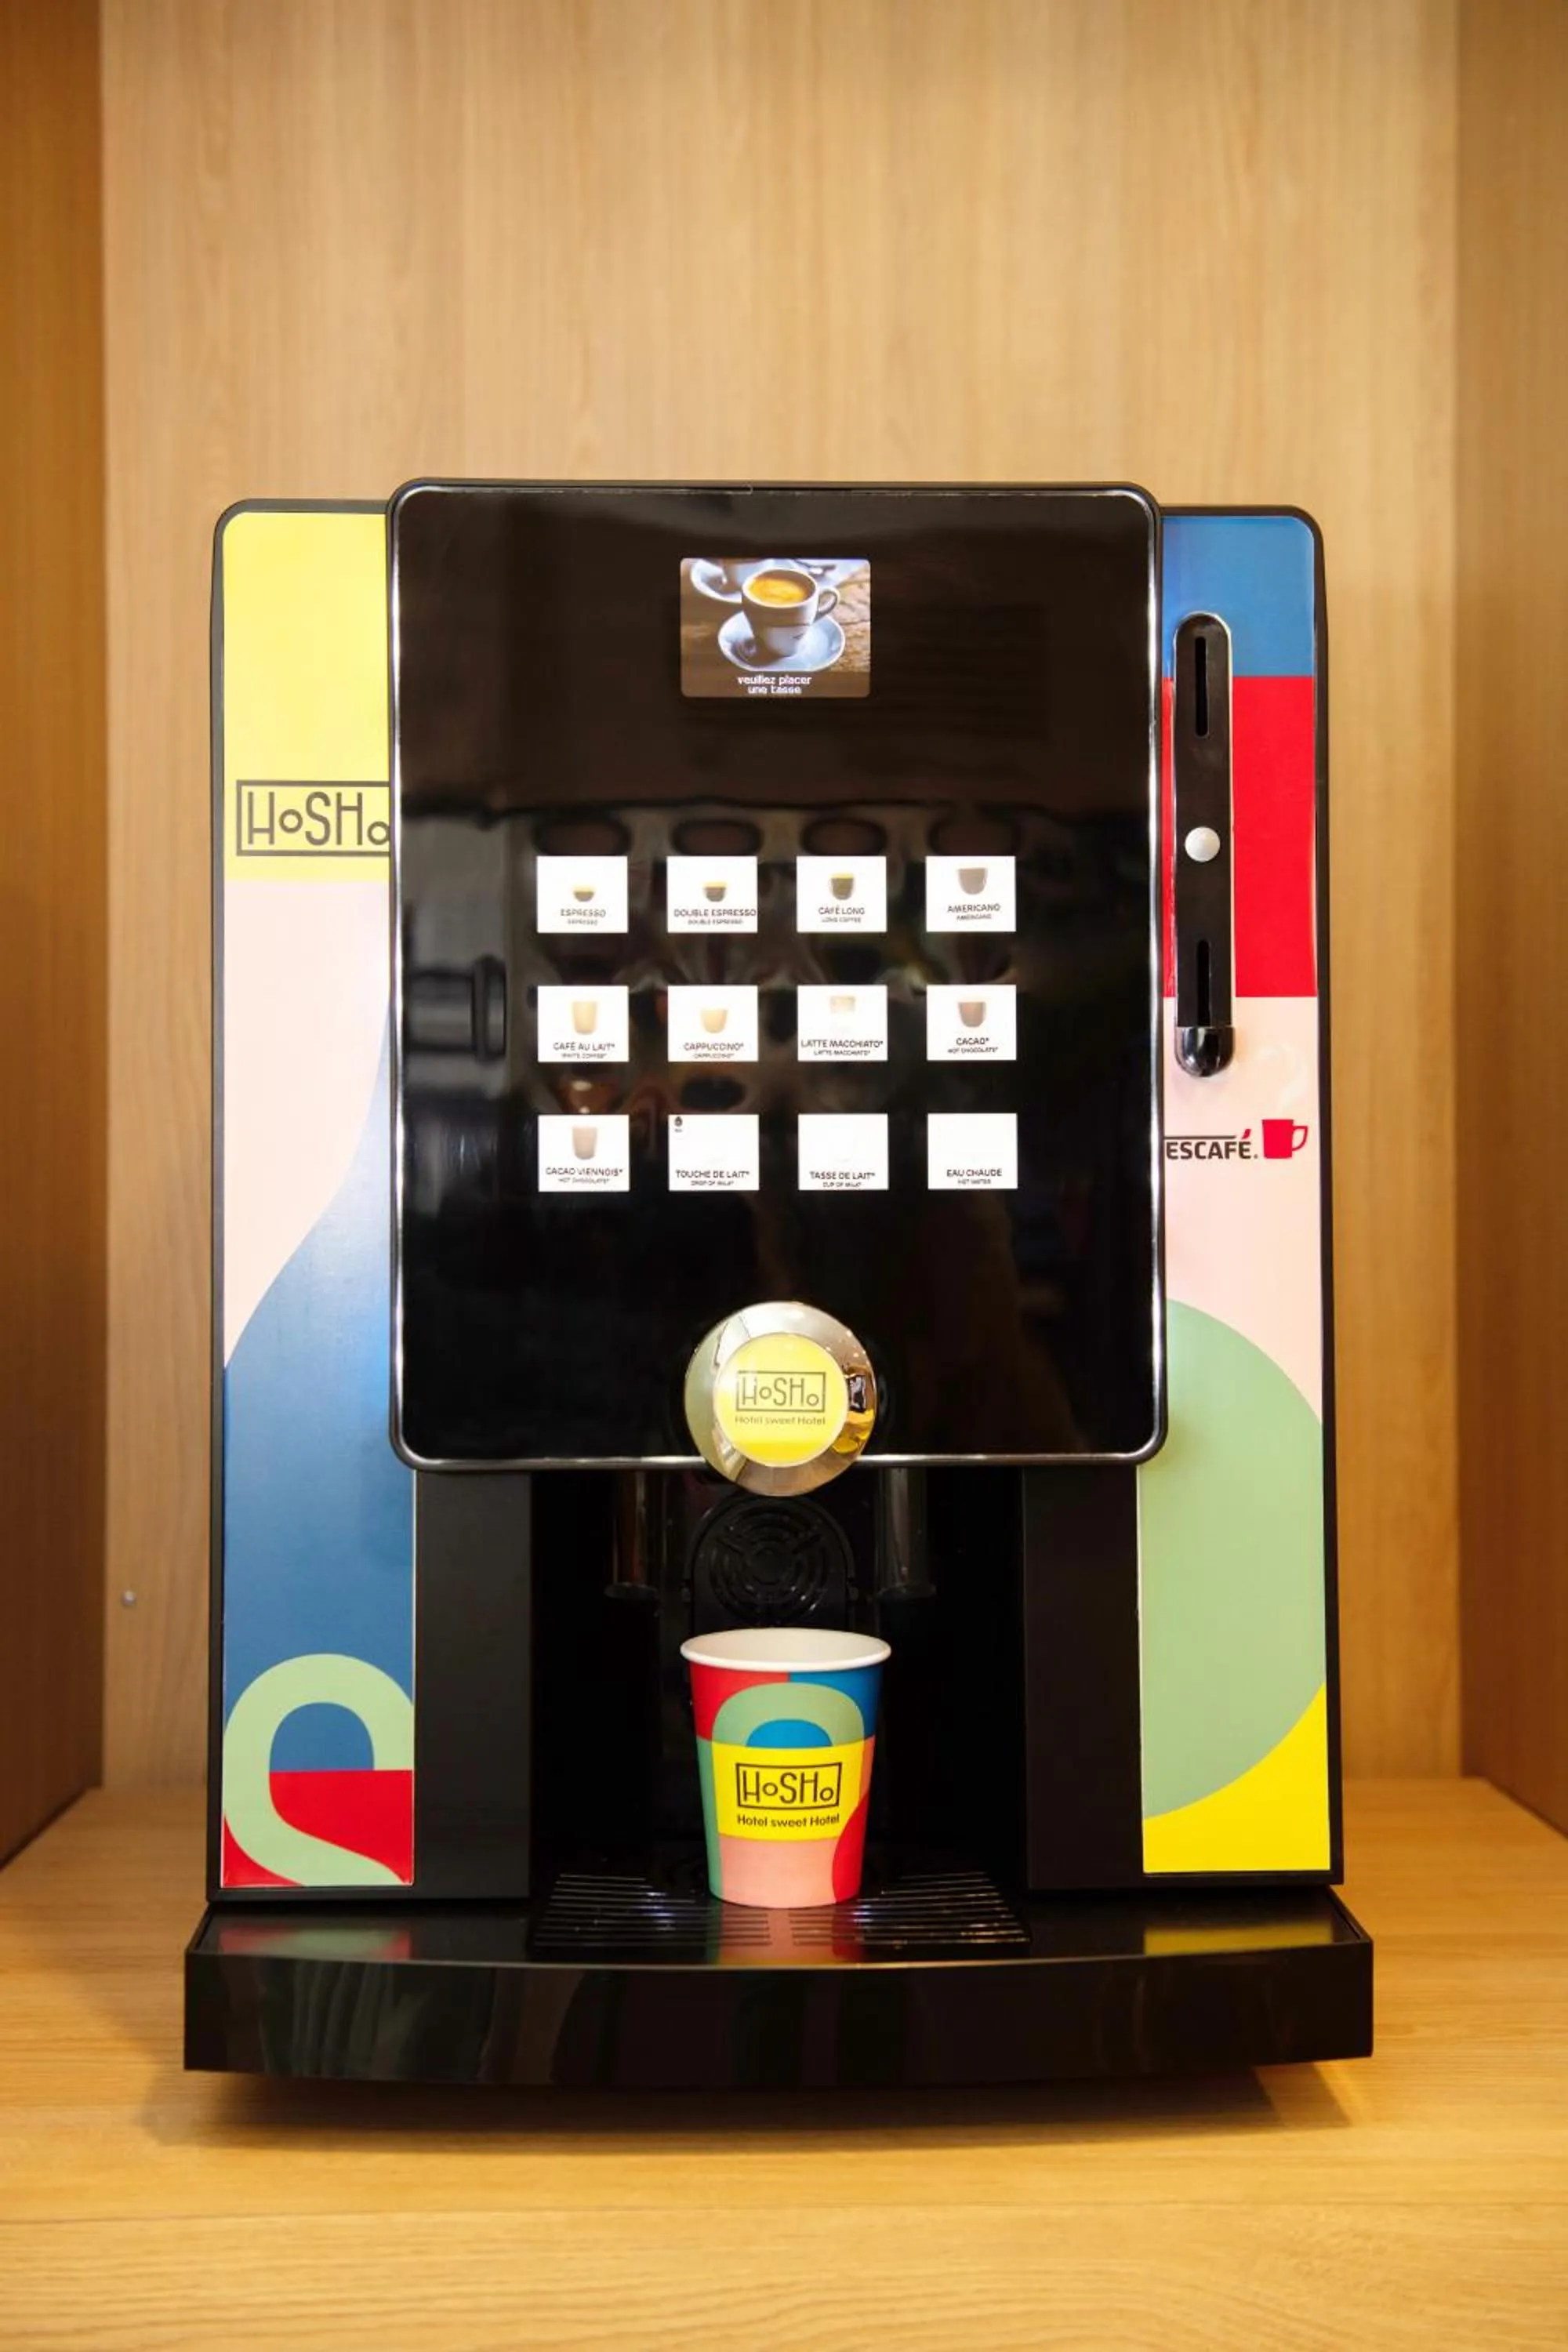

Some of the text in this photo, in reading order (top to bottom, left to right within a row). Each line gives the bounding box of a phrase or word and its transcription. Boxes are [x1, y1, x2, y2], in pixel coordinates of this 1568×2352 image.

[738, 674, 812, 686] veuillez placer
[748, 684, 802, 695] une tasse
[560, 908, 606, 917] ESPRESSO
[673, 908, 757, 917] DOUBLE ESPRESSO
[818, 904, 840, 915] CAFÉ
[947, 903, 1001, 913] AMERICANO
[553, 1041, 575, 1051] CAFÉ
[578, 1042, 590, 1051] AU
[800, 1039, 827, 1047] LATTE
[545, 1167, 576, 1176] CACAO
[675, 1169, 710, 1178] TOUCHE
[713, 1170, 724, 1178] DE
[809, 1171, 836, 1180] TASSE
[838, 1171, 851, 1180] DE
[946, 1168, 1002, 1178] EAU CHAUDE
[797, 1416, 826, 1425] Hotel
[737, 1813, 840, 1828] Hotel sweet Hotel
